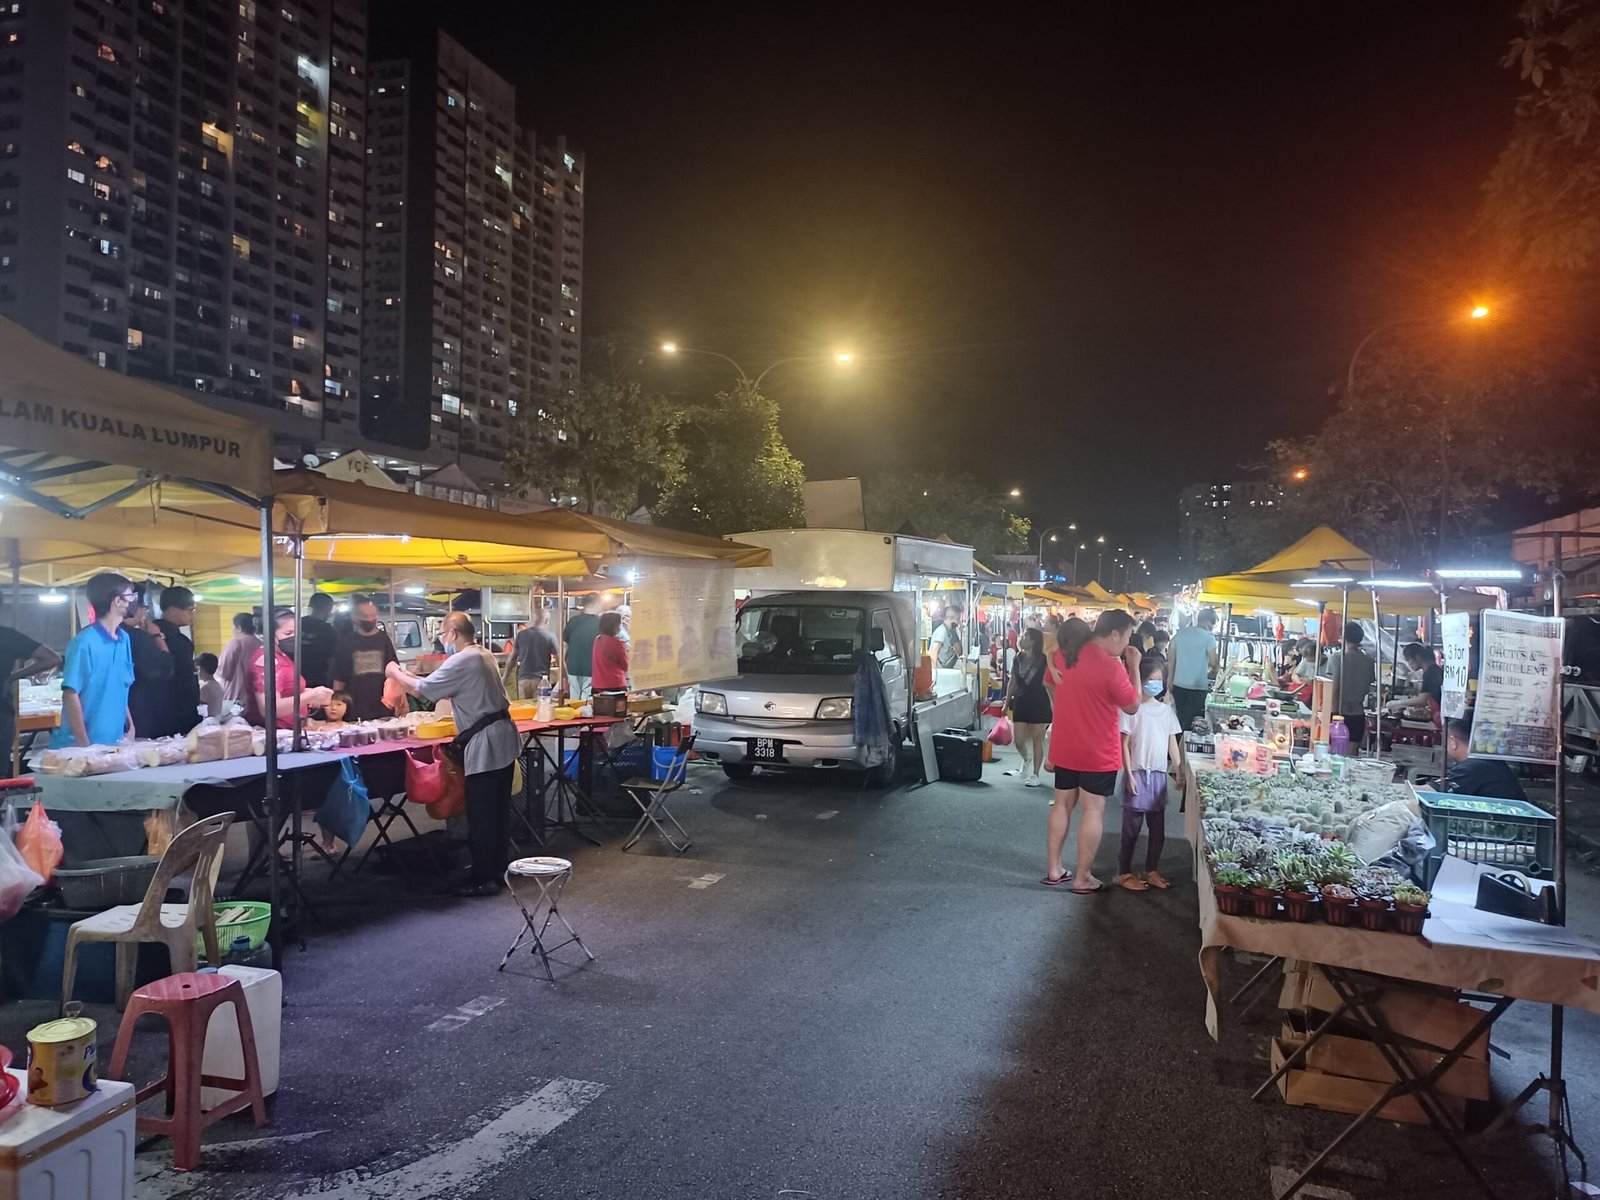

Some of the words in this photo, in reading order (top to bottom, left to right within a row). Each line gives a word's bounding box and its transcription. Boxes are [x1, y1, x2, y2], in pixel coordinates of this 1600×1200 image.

[62, 408, 147, 441] KUALA
[152, 427, 242, 458] LUMPUR
[1447, 644, 1453, 660] 3
[1454, 644, 1465, 660] for
[1489, 646, 1528, 661] CACTUS
[1529, 653, 1537, 662] &
[757, 738, 773, 748] BPM
[754, 747, 775, 757] 3318
